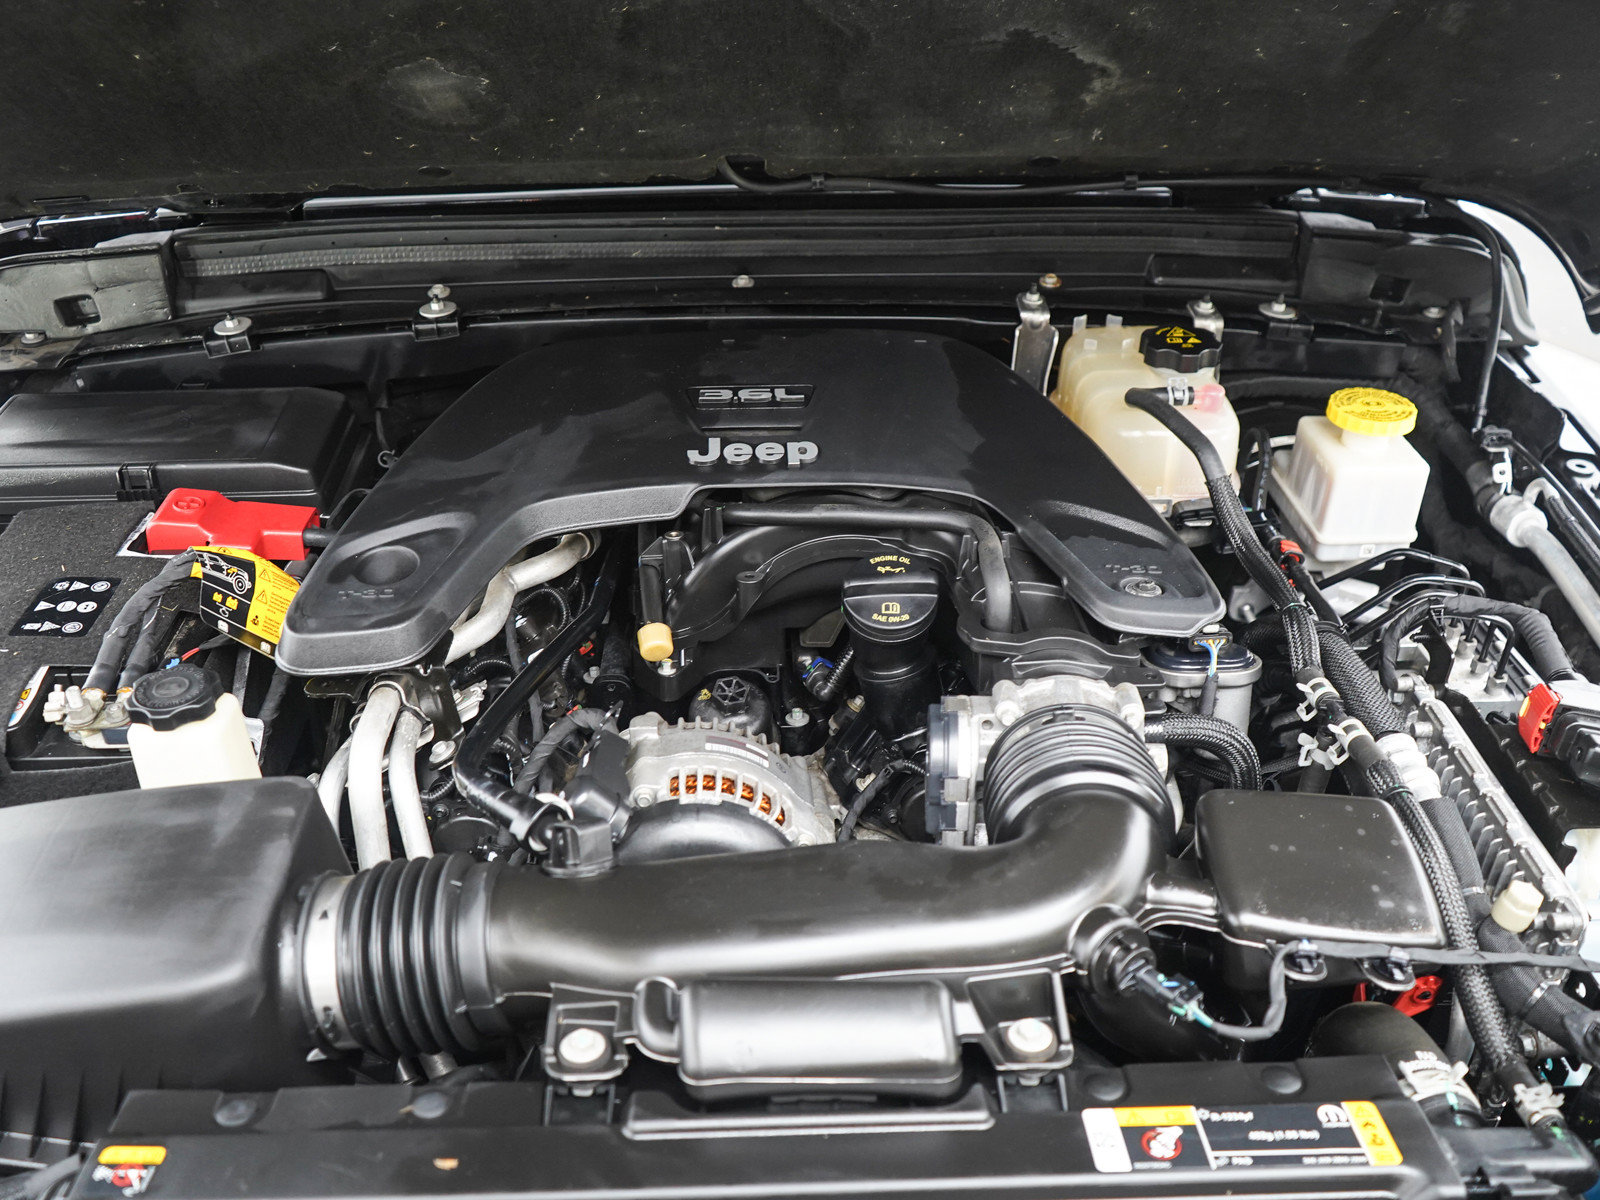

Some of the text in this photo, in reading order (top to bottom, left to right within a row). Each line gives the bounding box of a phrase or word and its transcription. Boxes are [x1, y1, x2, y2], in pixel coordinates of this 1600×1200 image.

[698, 388, 805, 404] 3.6L
[686, 437, 819, 468] Jeep
[869, 555, 911, 565] ENGINE OIL
[871, 613, 910, 623] SAE 0W-20
